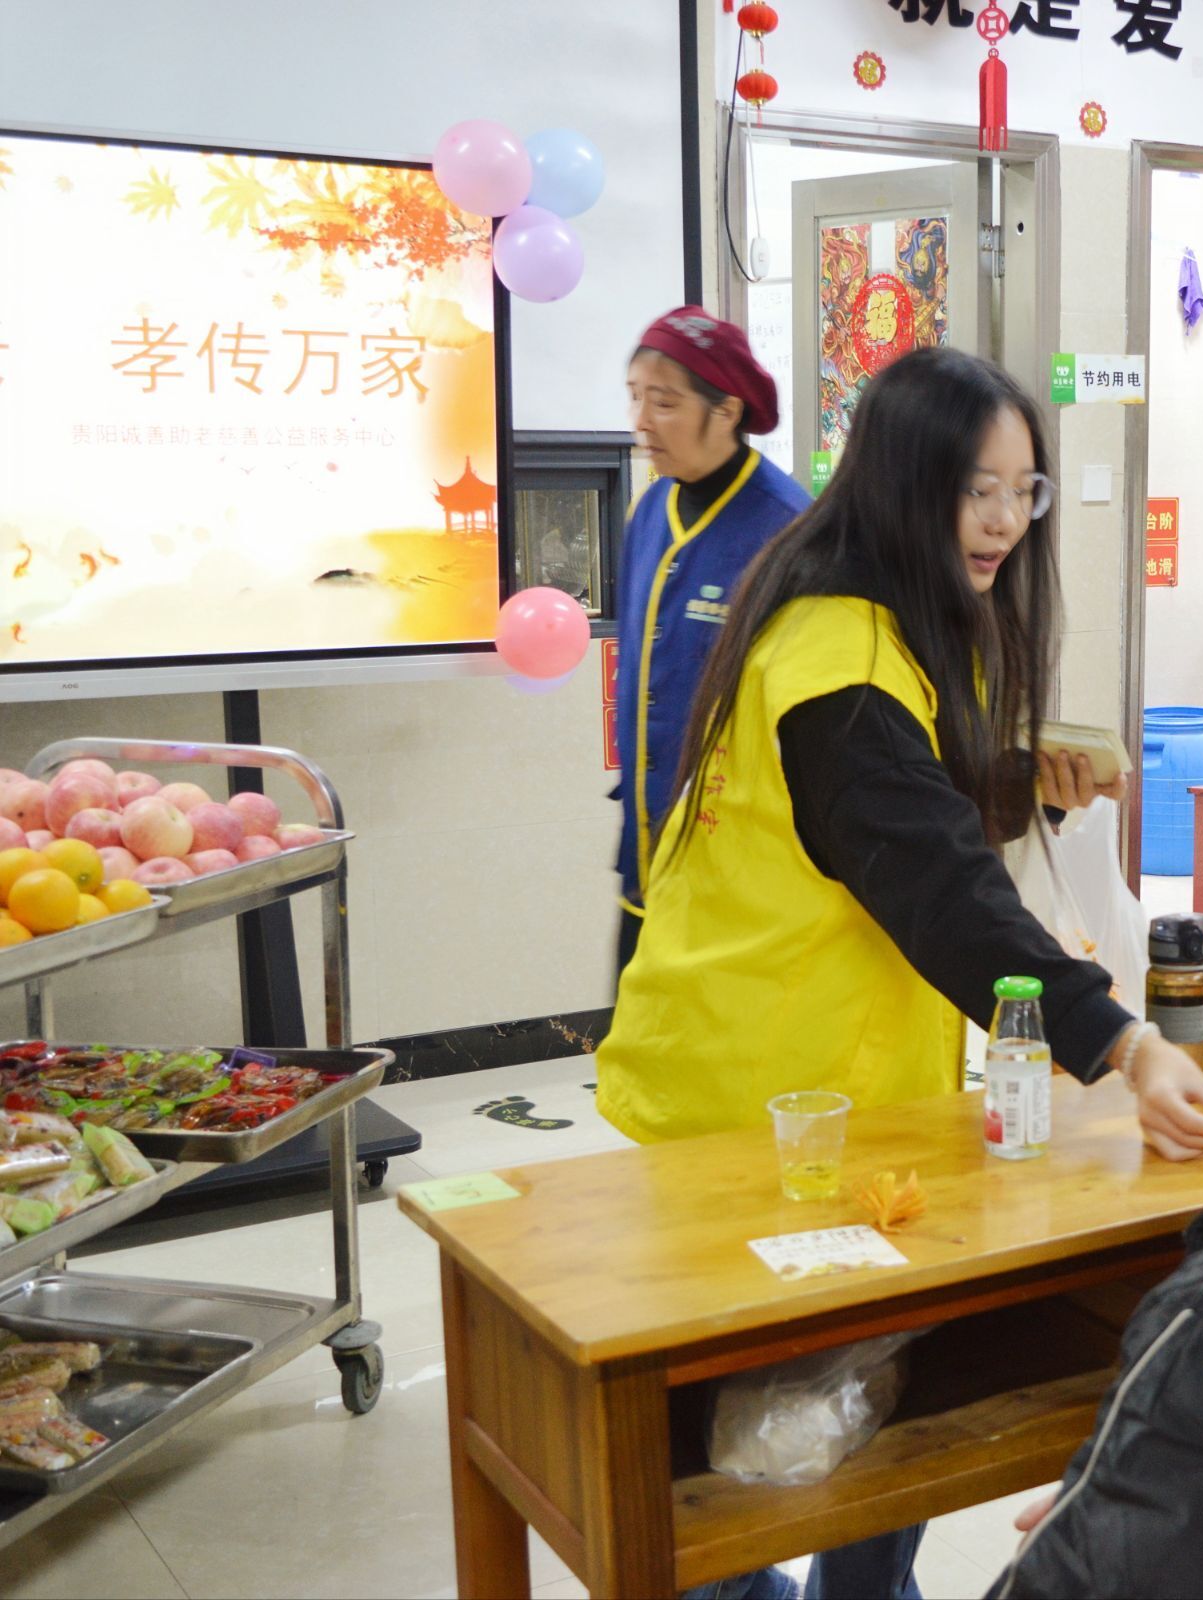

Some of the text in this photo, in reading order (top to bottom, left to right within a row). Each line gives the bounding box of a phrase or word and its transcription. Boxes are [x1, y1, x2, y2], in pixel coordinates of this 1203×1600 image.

[864, 289, 898, 344] 福
[110, 317, 430, 401] 孝传万家
[1082, 371, 1141, 387] 节约用电
[1146, 512, 1174, 530] 台阶
